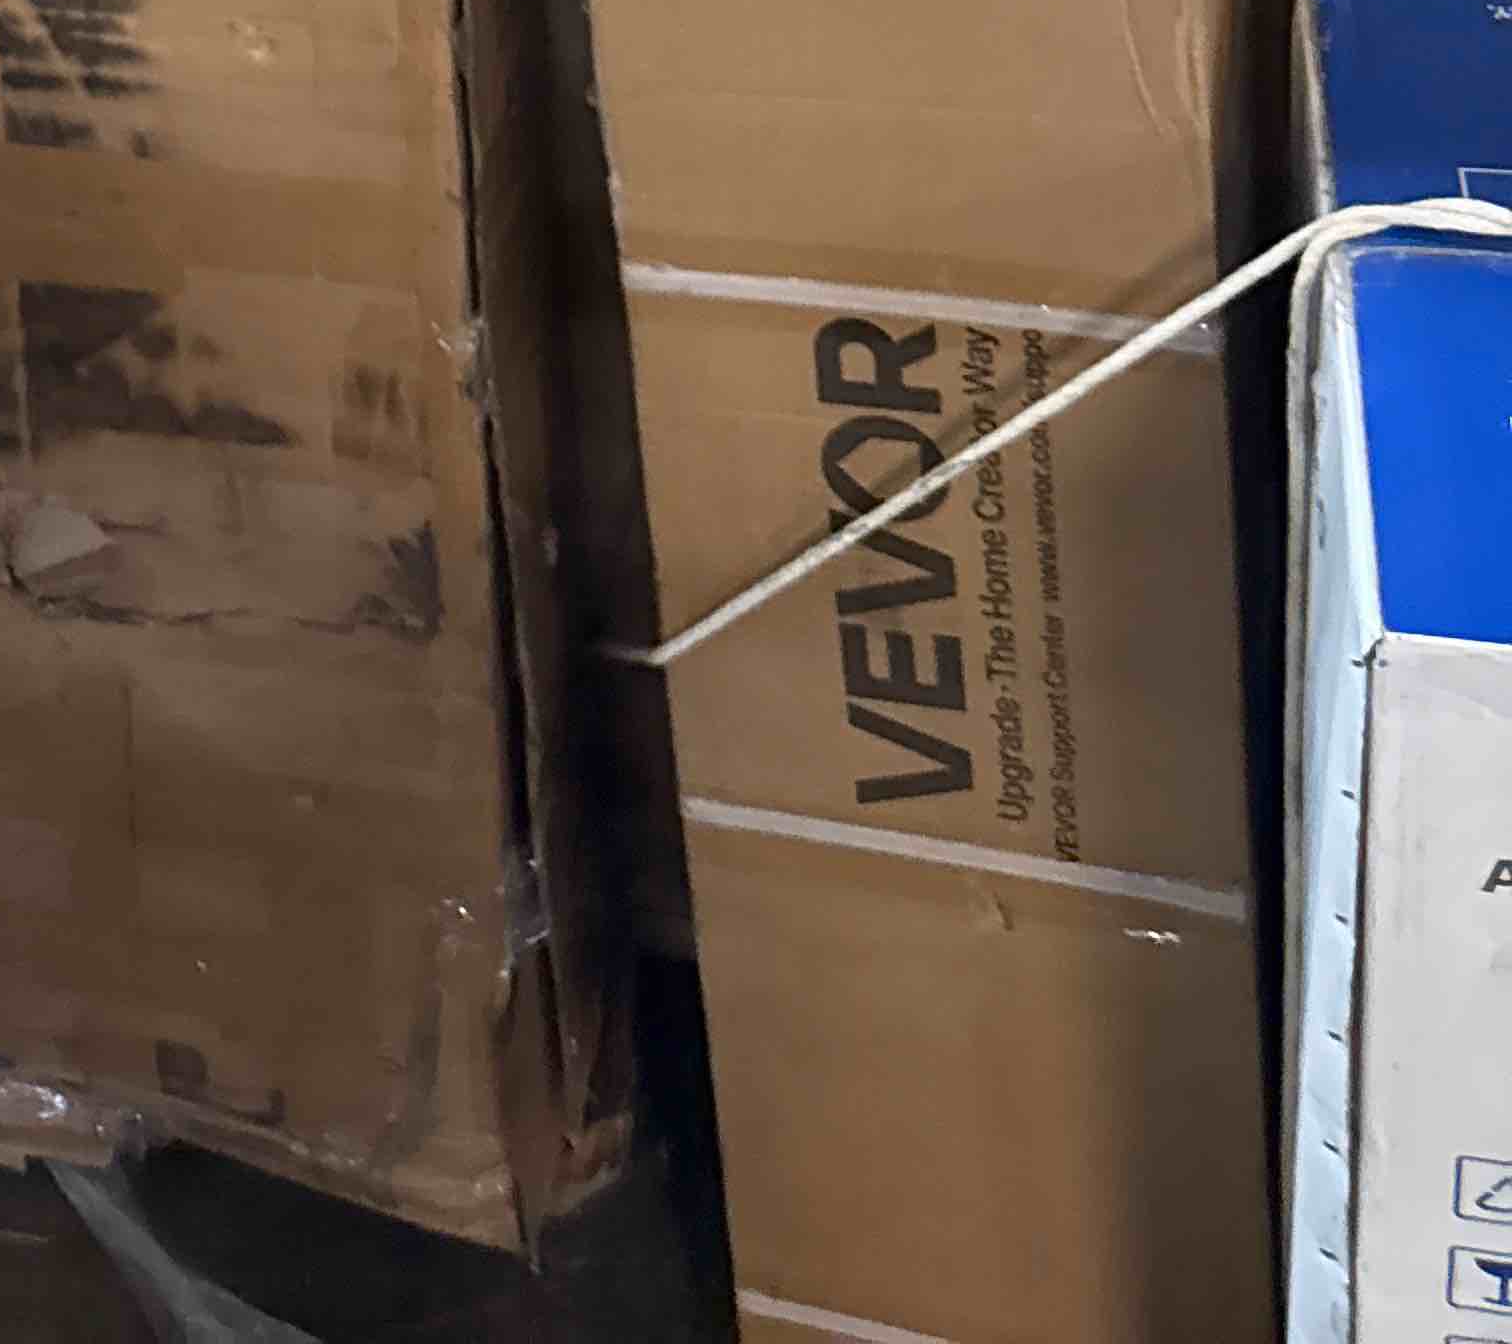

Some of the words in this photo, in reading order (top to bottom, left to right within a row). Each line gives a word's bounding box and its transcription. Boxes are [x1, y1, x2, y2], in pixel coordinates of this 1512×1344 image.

[962, 326, 1000, 395] Way
[969, 401, 1005, 522] Creaor
[813, 317, 973, 804] VEVOR
[978, 529, 1012, 619] Home
[1047, 692, 1077, 783] Support
